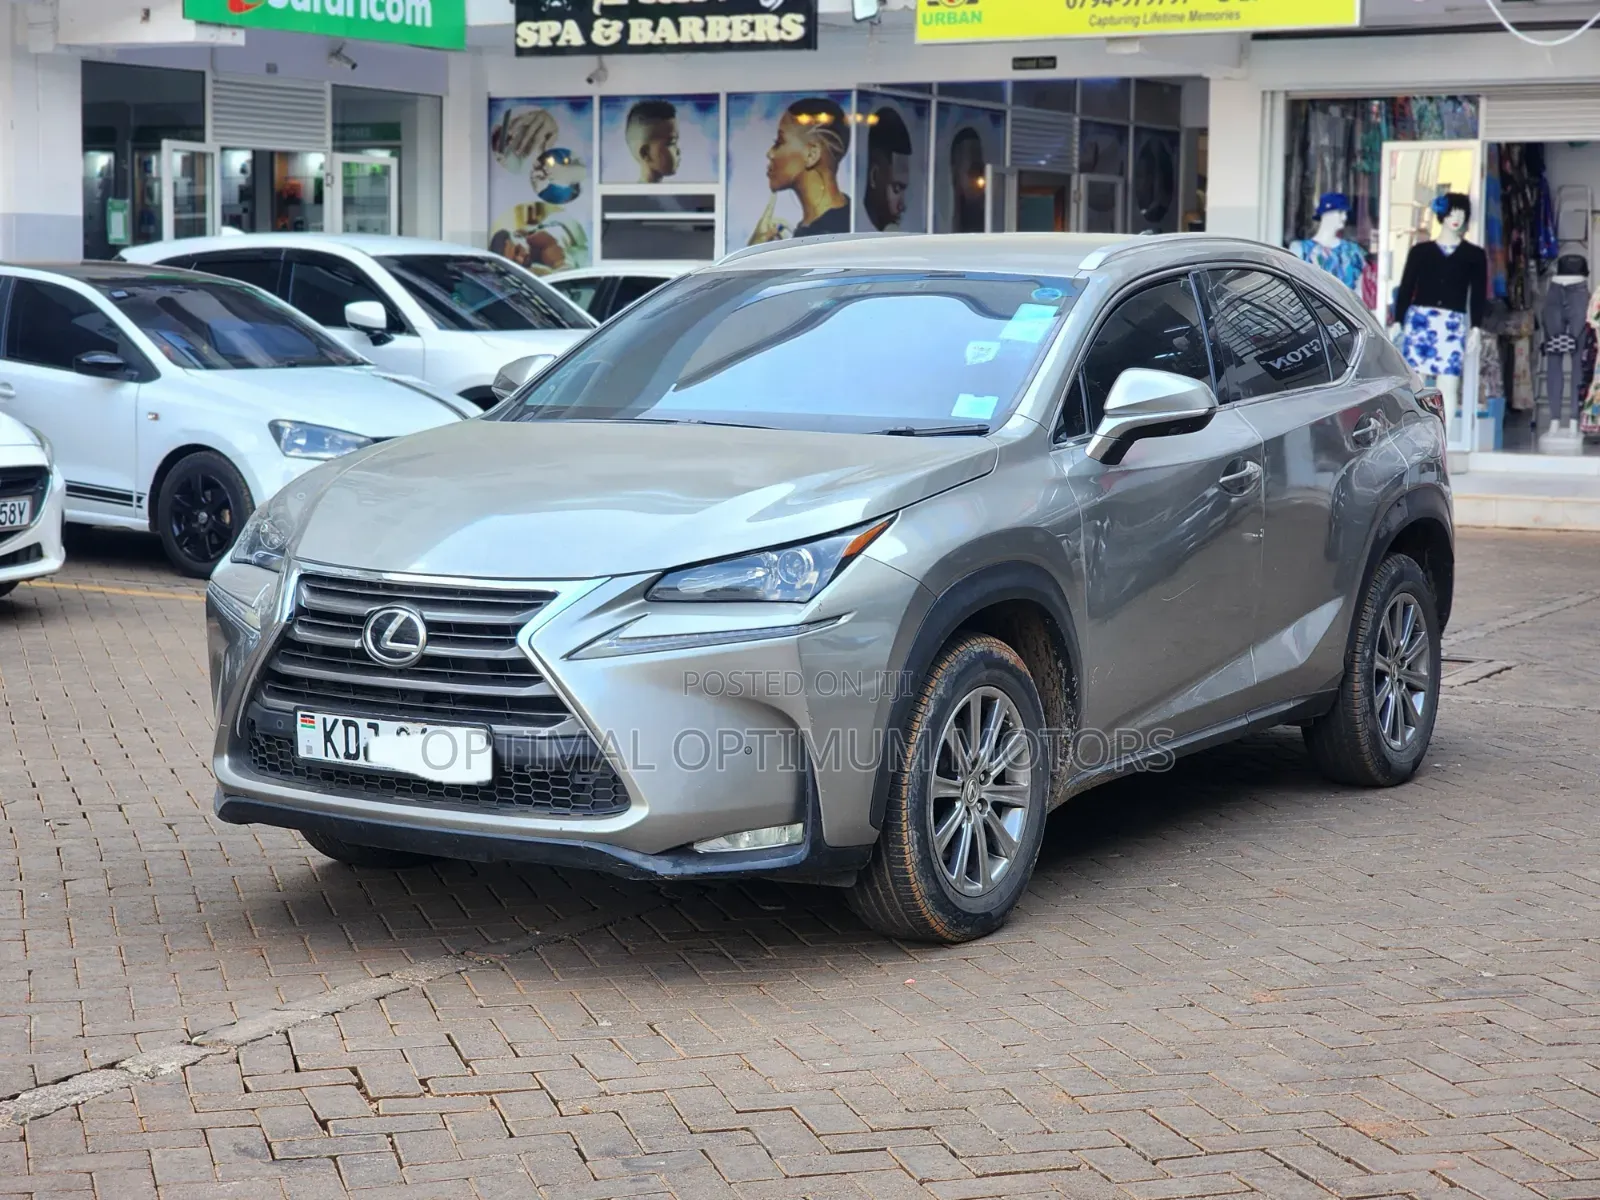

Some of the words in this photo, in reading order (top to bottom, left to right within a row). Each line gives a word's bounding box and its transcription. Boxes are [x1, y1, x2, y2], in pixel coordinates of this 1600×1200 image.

[268, 0, 433, 28] aricom
[921, 10, 983, 26] URBAN
[1088, 13, 1141, 28] Capturing
[1142, 12, 1185, 25] Lifetime
[1188, 10, 1241, 22] Memories
[515, 19, 586, 48] SPA
[591, 18, 624, 47] &
[627, 13, 806, 46] BARBERS
